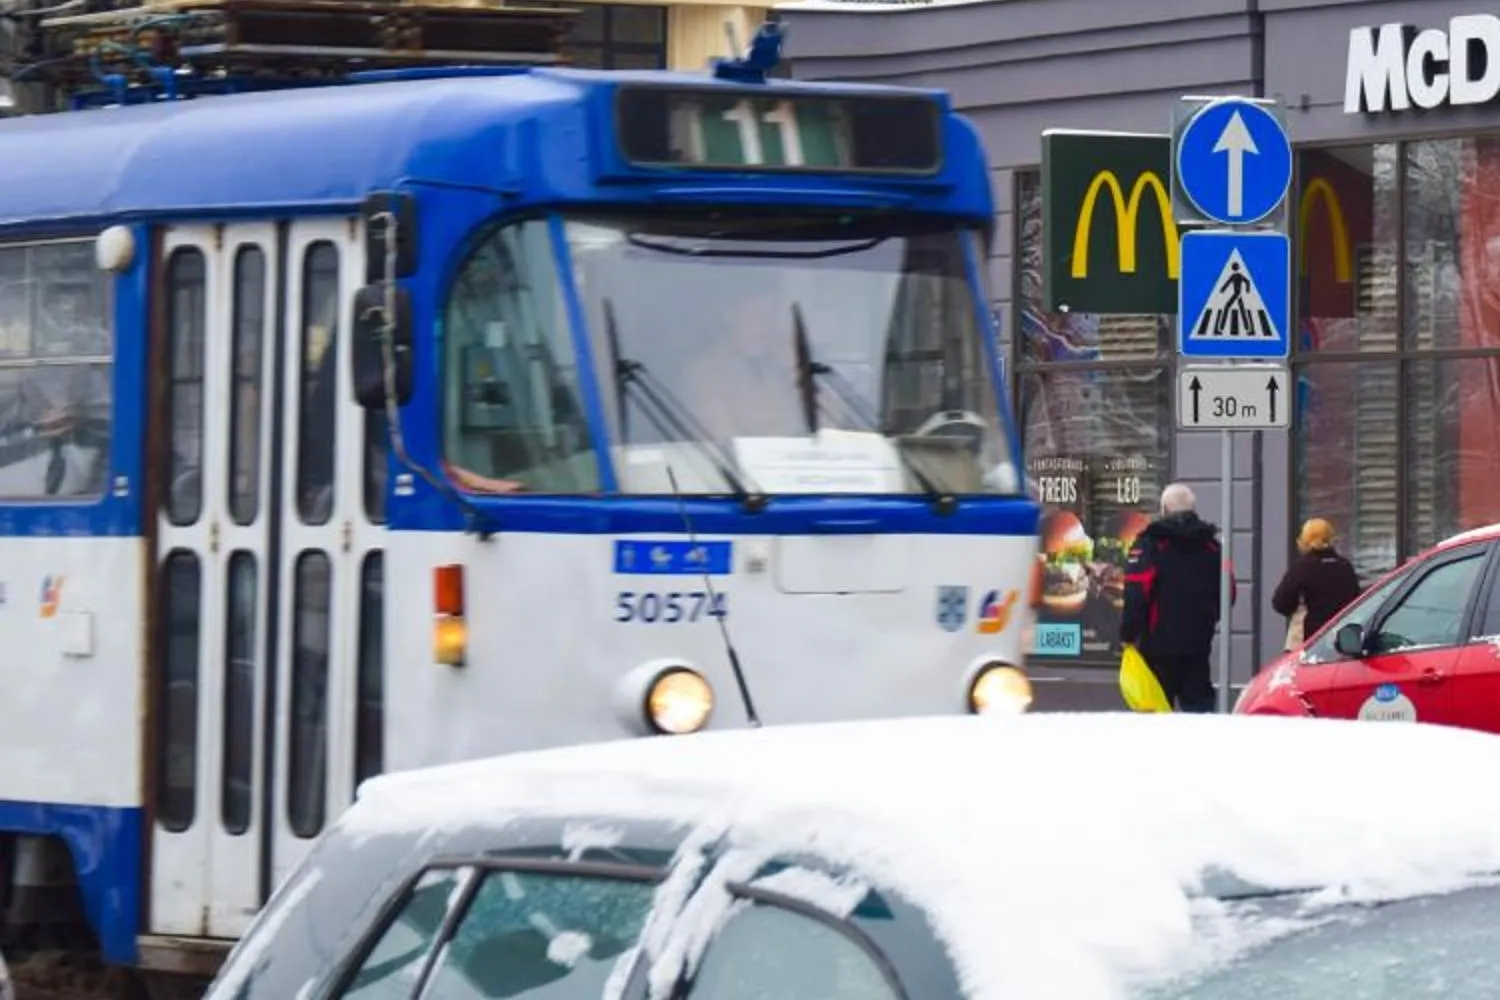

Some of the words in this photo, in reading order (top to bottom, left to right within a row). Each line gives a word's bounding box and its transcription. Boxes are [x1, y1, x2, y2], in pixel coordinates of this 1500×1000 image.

[722, 100, 804, 165] 11
[1212, 396, 1237, 418] 30
[1241, 404, 1257, 418] m
[1038, 476, 1078, 503] FREDS
[1116, 476, 1141, 504] LEO
[615, 592, 728, 623] 50574
